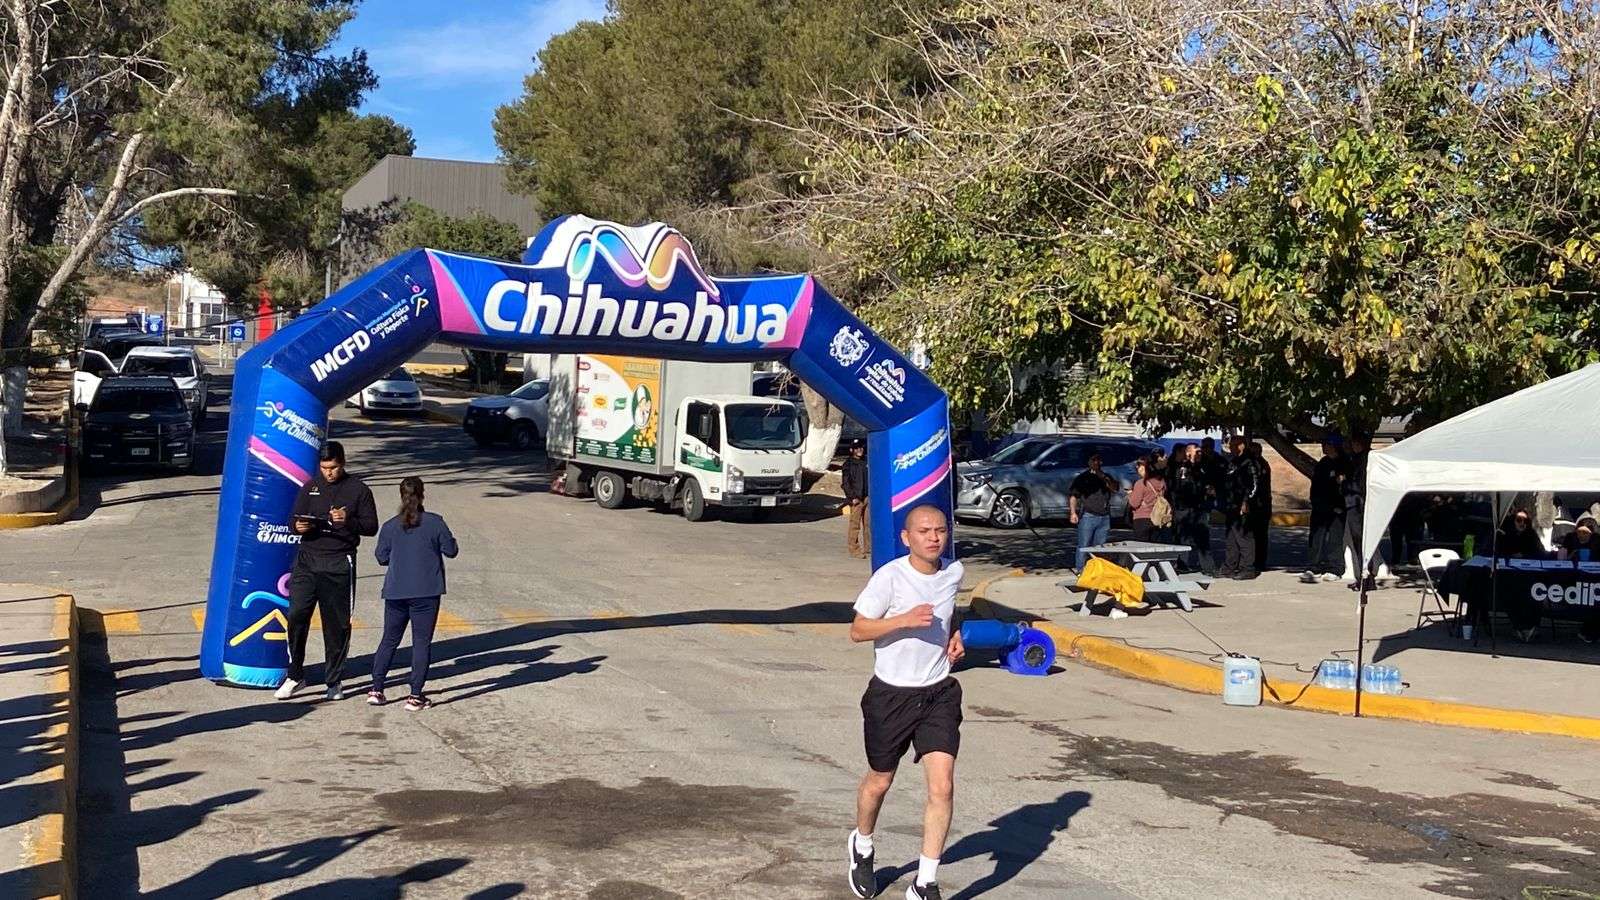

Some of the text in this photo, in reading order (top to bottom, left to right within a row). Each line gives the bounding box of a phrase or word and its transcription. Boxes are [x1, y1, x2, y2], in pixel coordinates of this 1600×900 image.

[483, 279, 789, 344] Chihuahua
[370, 316, 393, 335] Cultura
[384, 314, 409, 335] Deporte
[309, 328, 371, 383] IMCFD
[258, 521, 291, 533] Síguen
